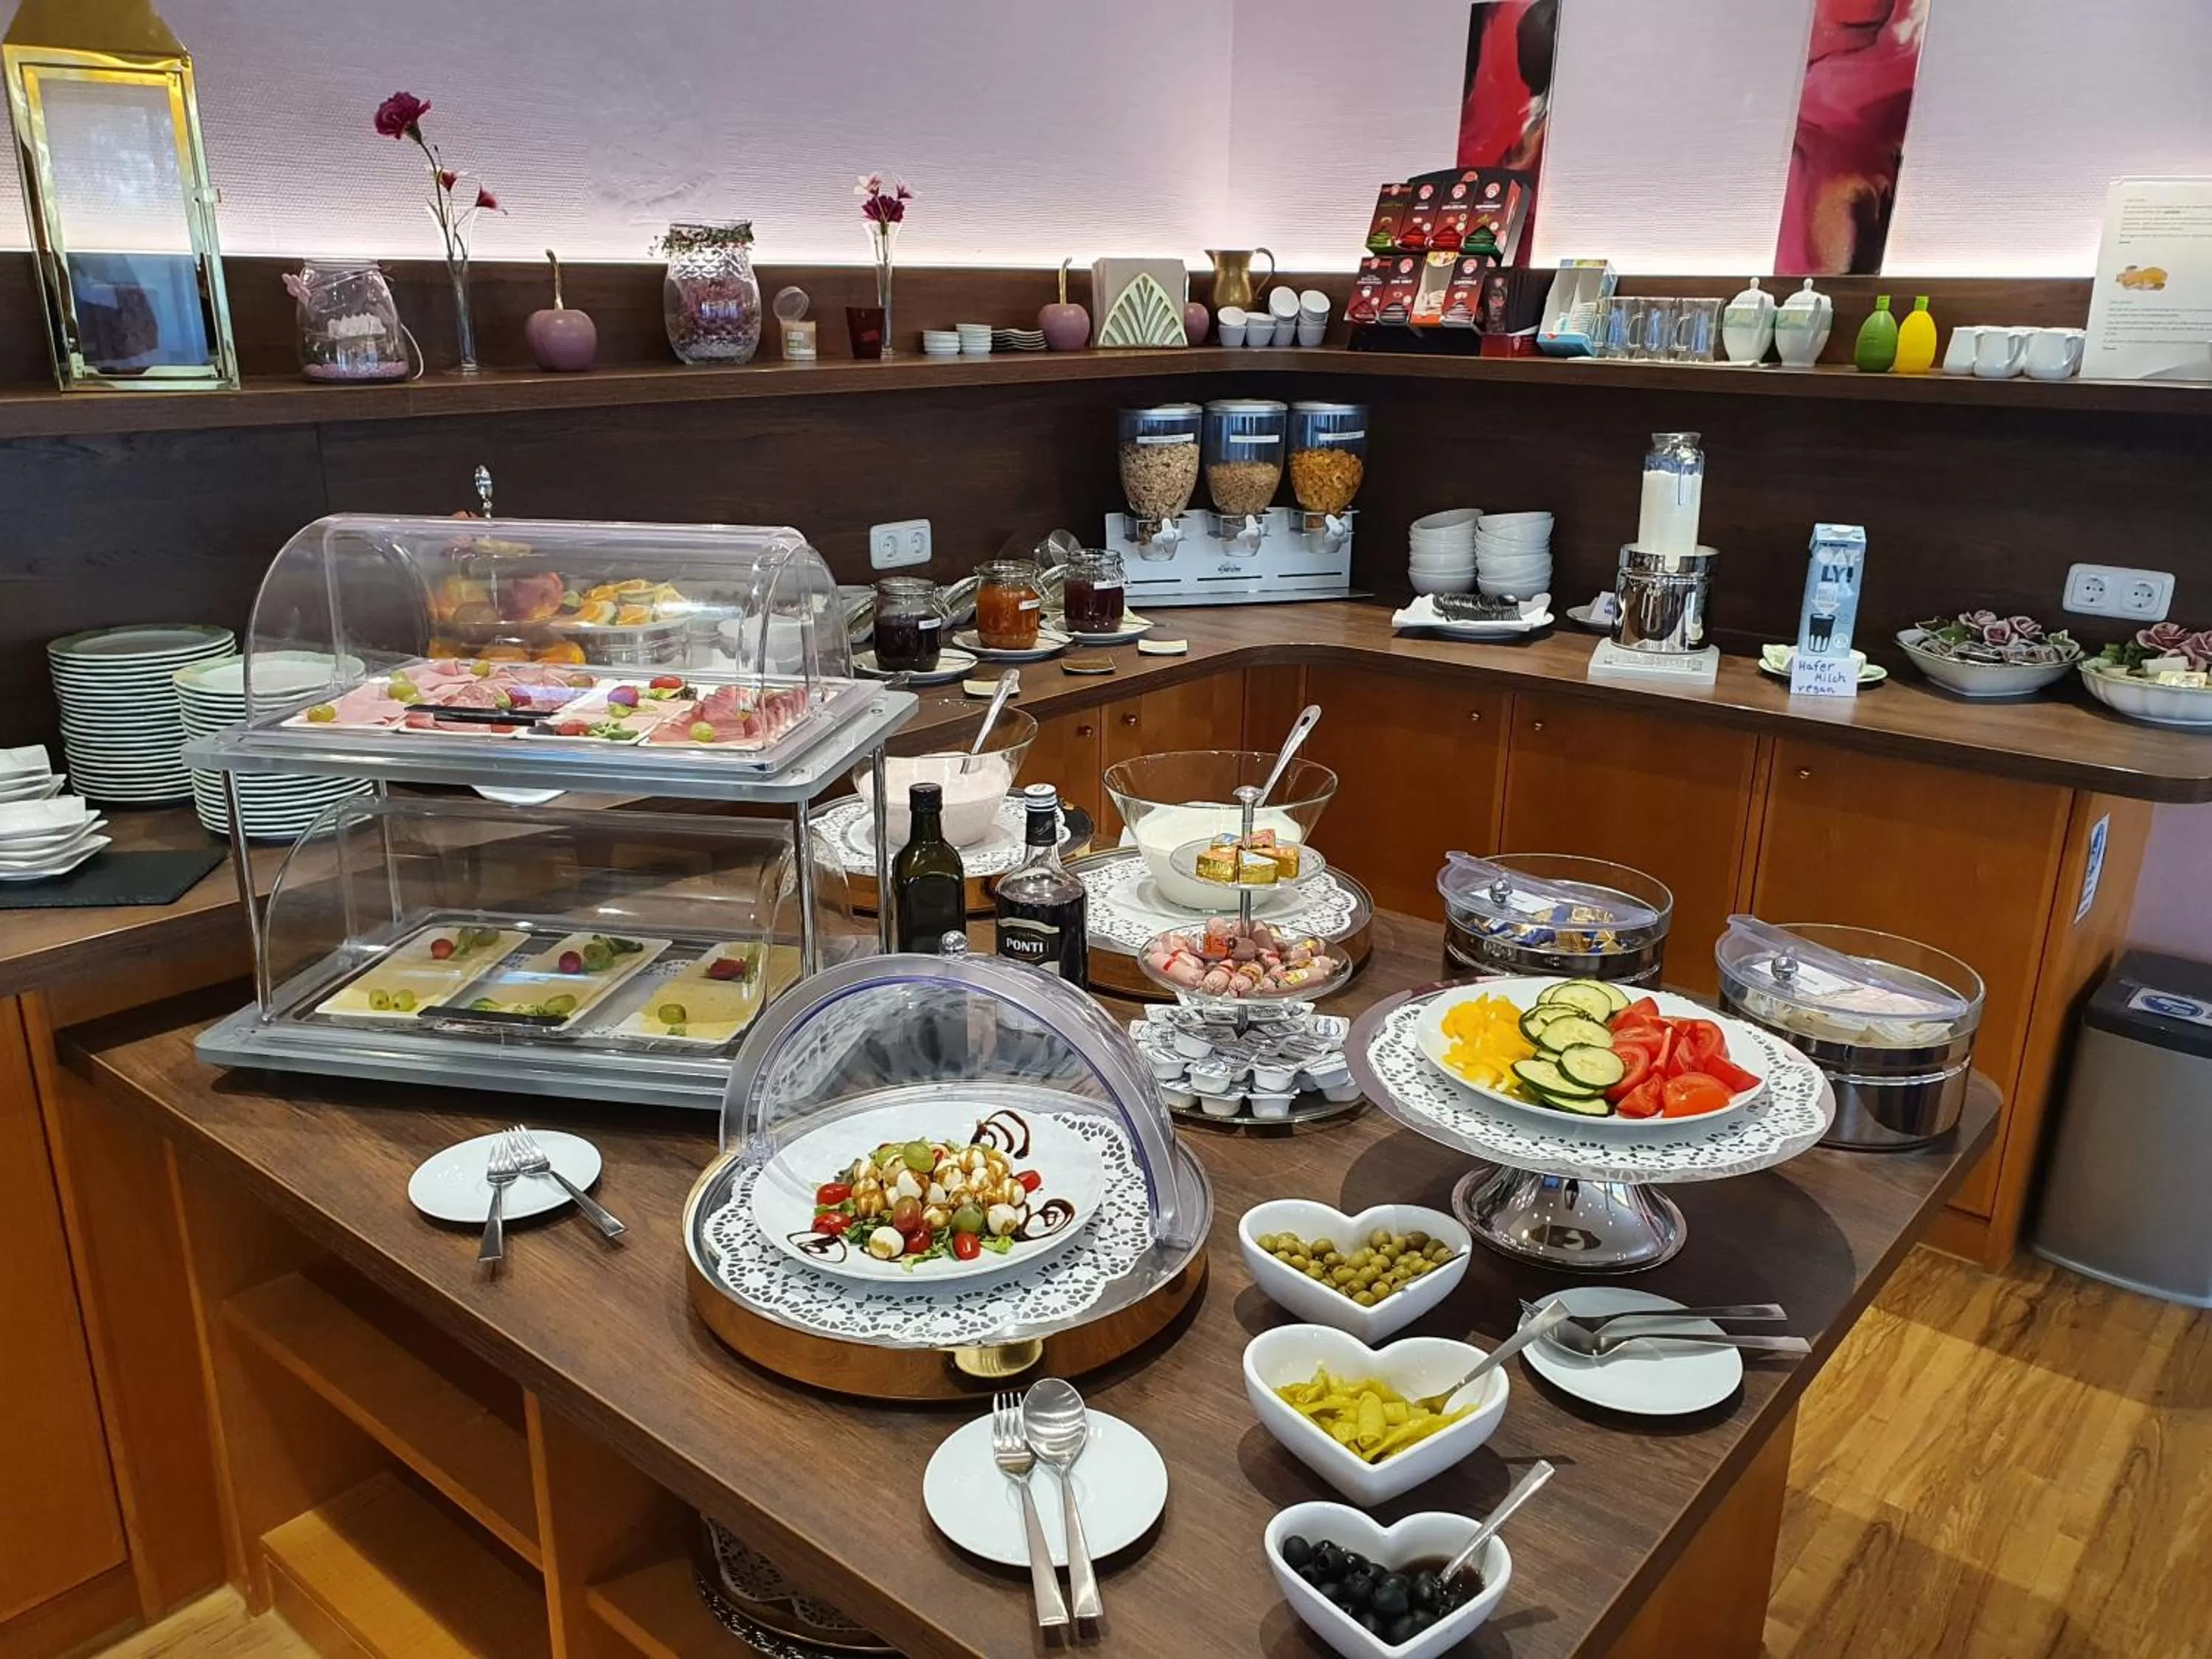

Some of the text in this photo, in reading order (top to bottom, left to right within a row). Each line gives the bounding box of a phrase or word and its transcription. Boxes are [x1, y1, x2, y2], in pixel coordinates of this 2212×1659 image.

[1821, 566, 1854, 582] LY!
[1798, 660, 1835, 672] Hafer
[1815, 671, 1846, 683] Milch
[1797, 684, 1836, 694] vegan
[1006, 937, 1043, 953] PONTI
